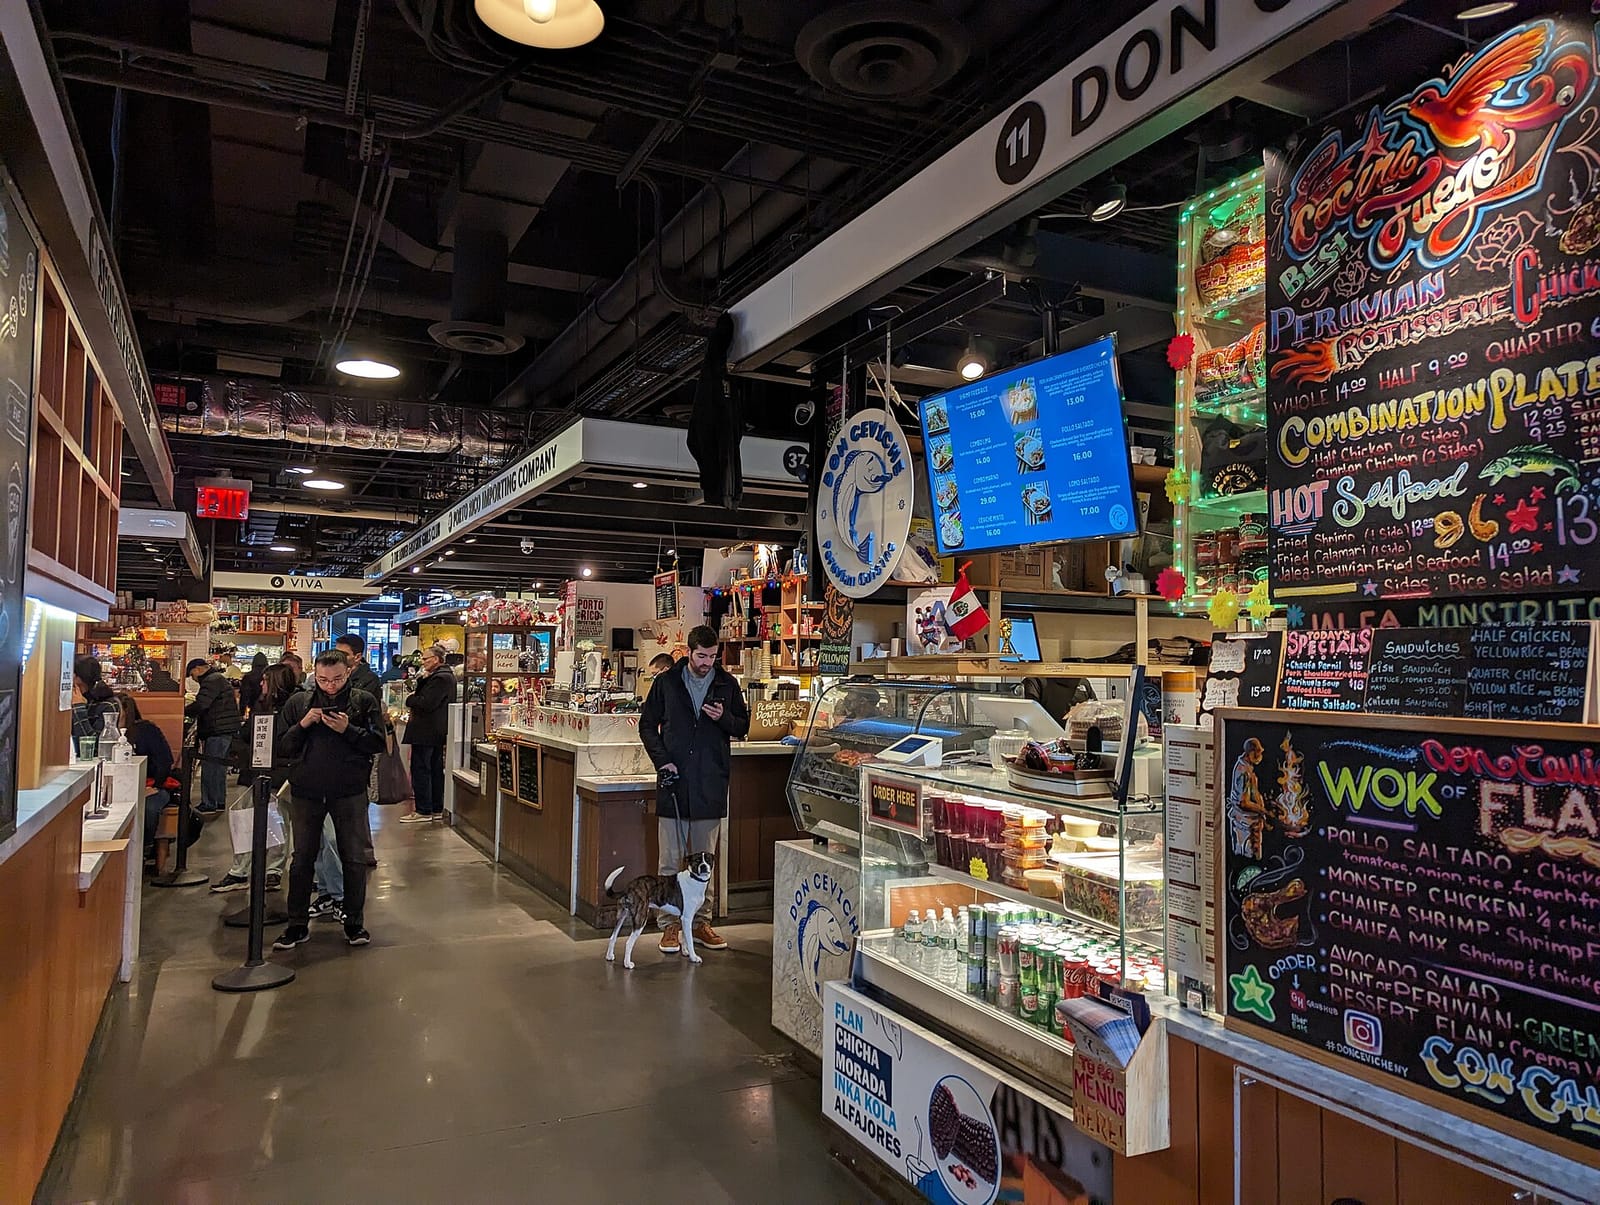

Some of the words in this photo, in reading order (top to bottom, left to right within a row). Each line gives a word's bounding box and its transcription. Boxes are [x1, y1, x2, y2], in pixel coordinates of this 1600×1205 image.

[1005, 118, 1030, 166] 11
[1071, 0, 1216, 136] DON
[1270, 270, 1446, 351] PERUVIAN
[1339, 289, 1512, 366] ROTISSERIE
[1273, 390, 1328, 414] WHOLE
[1378, 362, 1422, 390] HALF
[1486, 322, 1583, 363] QUARTER
[1277, 378, 1488, 468] COMBINATION
[518, 444, 558, 489] COMPANY
[823, 437, 849, 488] DON
[850, 420, 905, 477] CEVICHE
[1314, 449, 1337, 467] Half
[1341, 442, 1393, 462] Chicken
[1270, 478, 1330, 528] HOT
[1277, 535, 1308, 549] Fried
[1277, 550, 1309, 566] Fried
[1314, 544, 1366, 564] Calamari
[1377, 556, 1413, 573] Fried
[1416, 549, 1482, 574] Seafood
[290, 578, 323, 589] VIVA
[1447, 573, 1488, 591] Rice
[1500, 566, 1553, 589] Salad
[577, 599, 604, 610] PORTO
[580, 610, 600, 621] RICO
[495, 652, 517, 660] Order
[1287, 628, 1371, 656] SPECIALS
[496, 661, 514, 669] here
[873, 785, 895, 802] ORDER
[897, 790, 916, 808] HERE
[1316, 759, 1443, 820] WOK
[1440, 785, 1468, 799] OF
[1327, 826, 1390, 850] POLLO
[1403, 838, 1512, 872] SALTADO
[790, 878, 811, 922] DON
[1408, 929, 1448, 951] MIX
[1458, 942, 1525, 972] Shrimp
[1506, 926, 1584, 960] Shrimp
[1269, 954, 1317, 980] ORDER
[834, 1002, 863, 1034] FLAN
[835, 1030, 881, 1069] CHICHA
[1419, 1036, 1516, 1094] CON
[835, 1055, 887, 1097] MORADA
[1074, 1069, 1126, 1117] MENUS
[834, 1071, 862, 1106] INKA
[864, 1091, 898, 1132] KOLA
[834, 1095, 902, 1160] ALFAJORES
